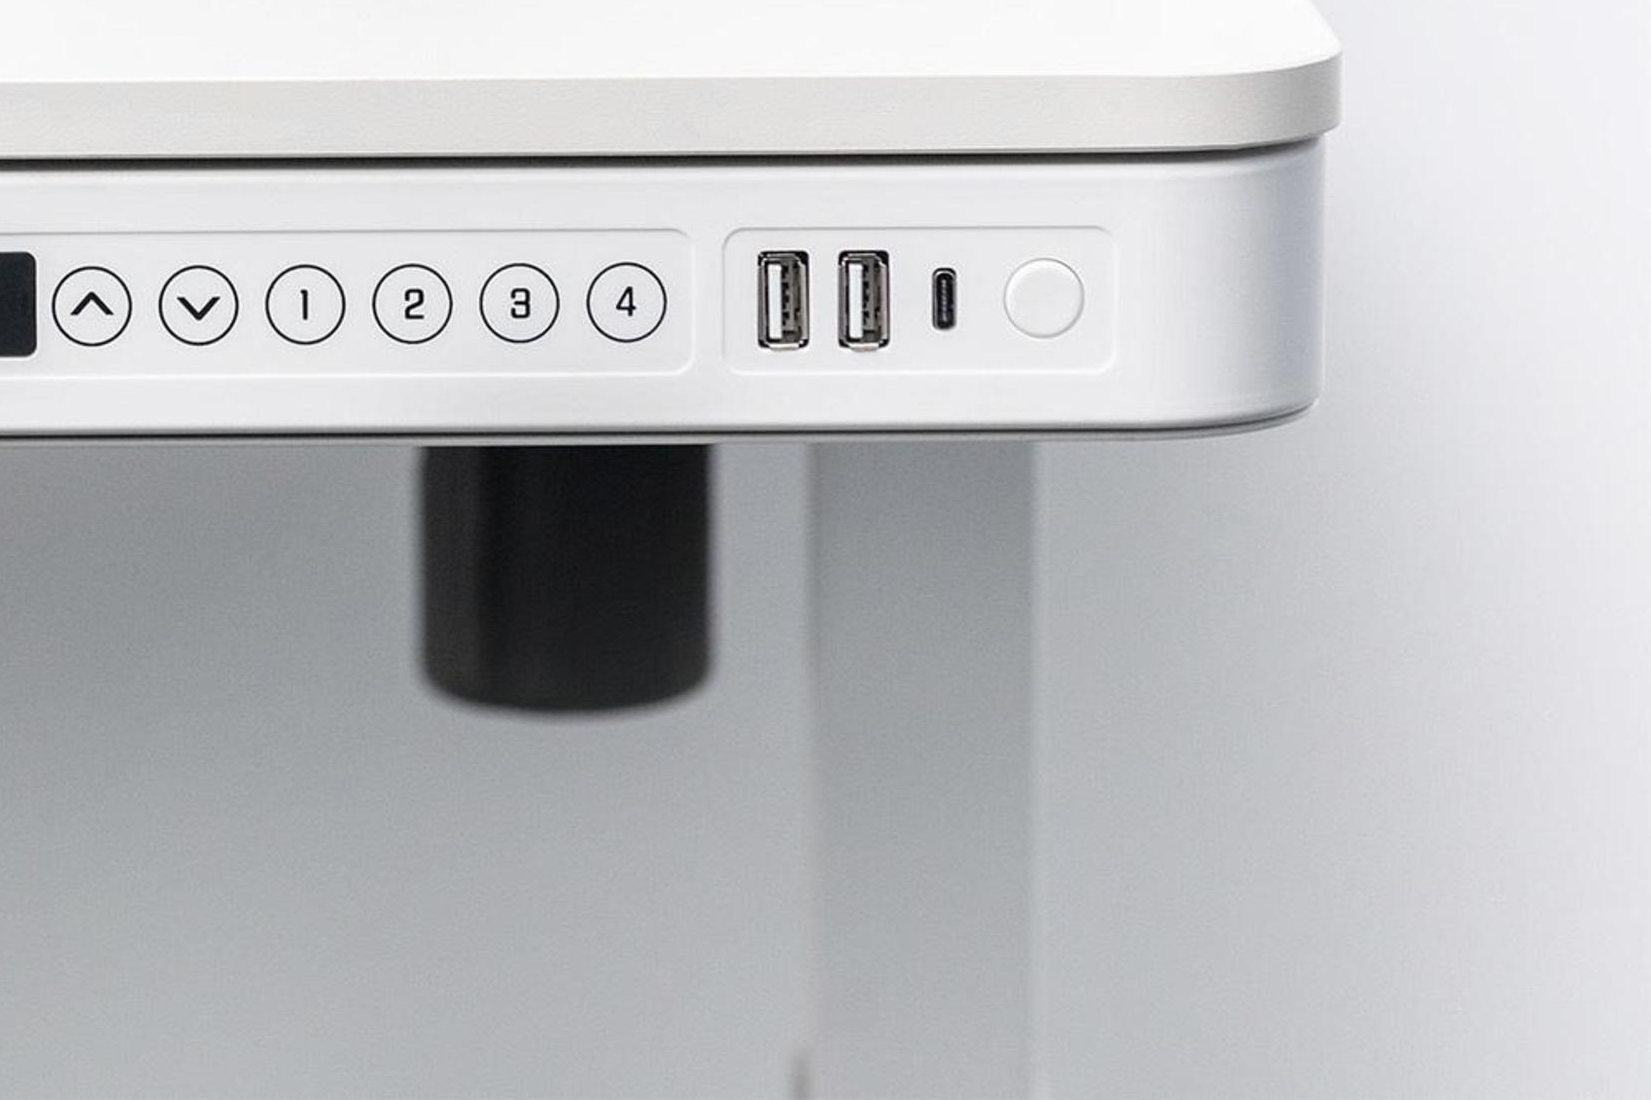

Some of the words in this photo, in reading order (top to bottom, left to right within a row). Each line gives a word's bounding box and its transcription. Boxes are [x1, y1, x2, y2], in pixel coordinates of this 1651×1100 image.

[300, 288, 309, 321] 1
[404, 288, 425, 320] 2
[510, 287, 531, 320] 3
[615, 285, 637, 317] 4
